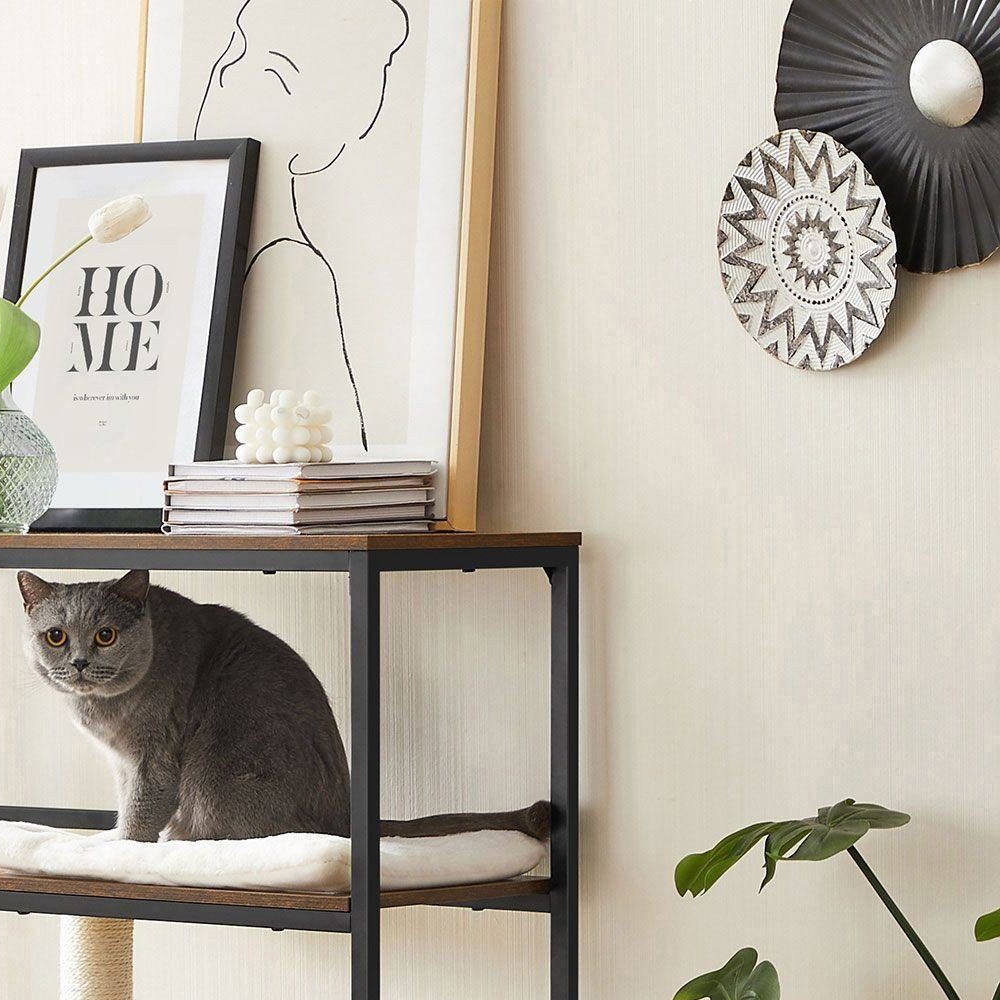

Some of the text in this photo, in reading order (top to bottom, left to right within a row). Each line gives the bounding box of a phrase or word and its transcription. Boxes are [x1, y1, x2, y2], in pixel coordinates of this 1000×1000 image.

[74, 263, 164, 317] HO
[66, 320, 161, 373] ME
[115, 393, 128, 401] with
[128, 395, 140, 404] you
